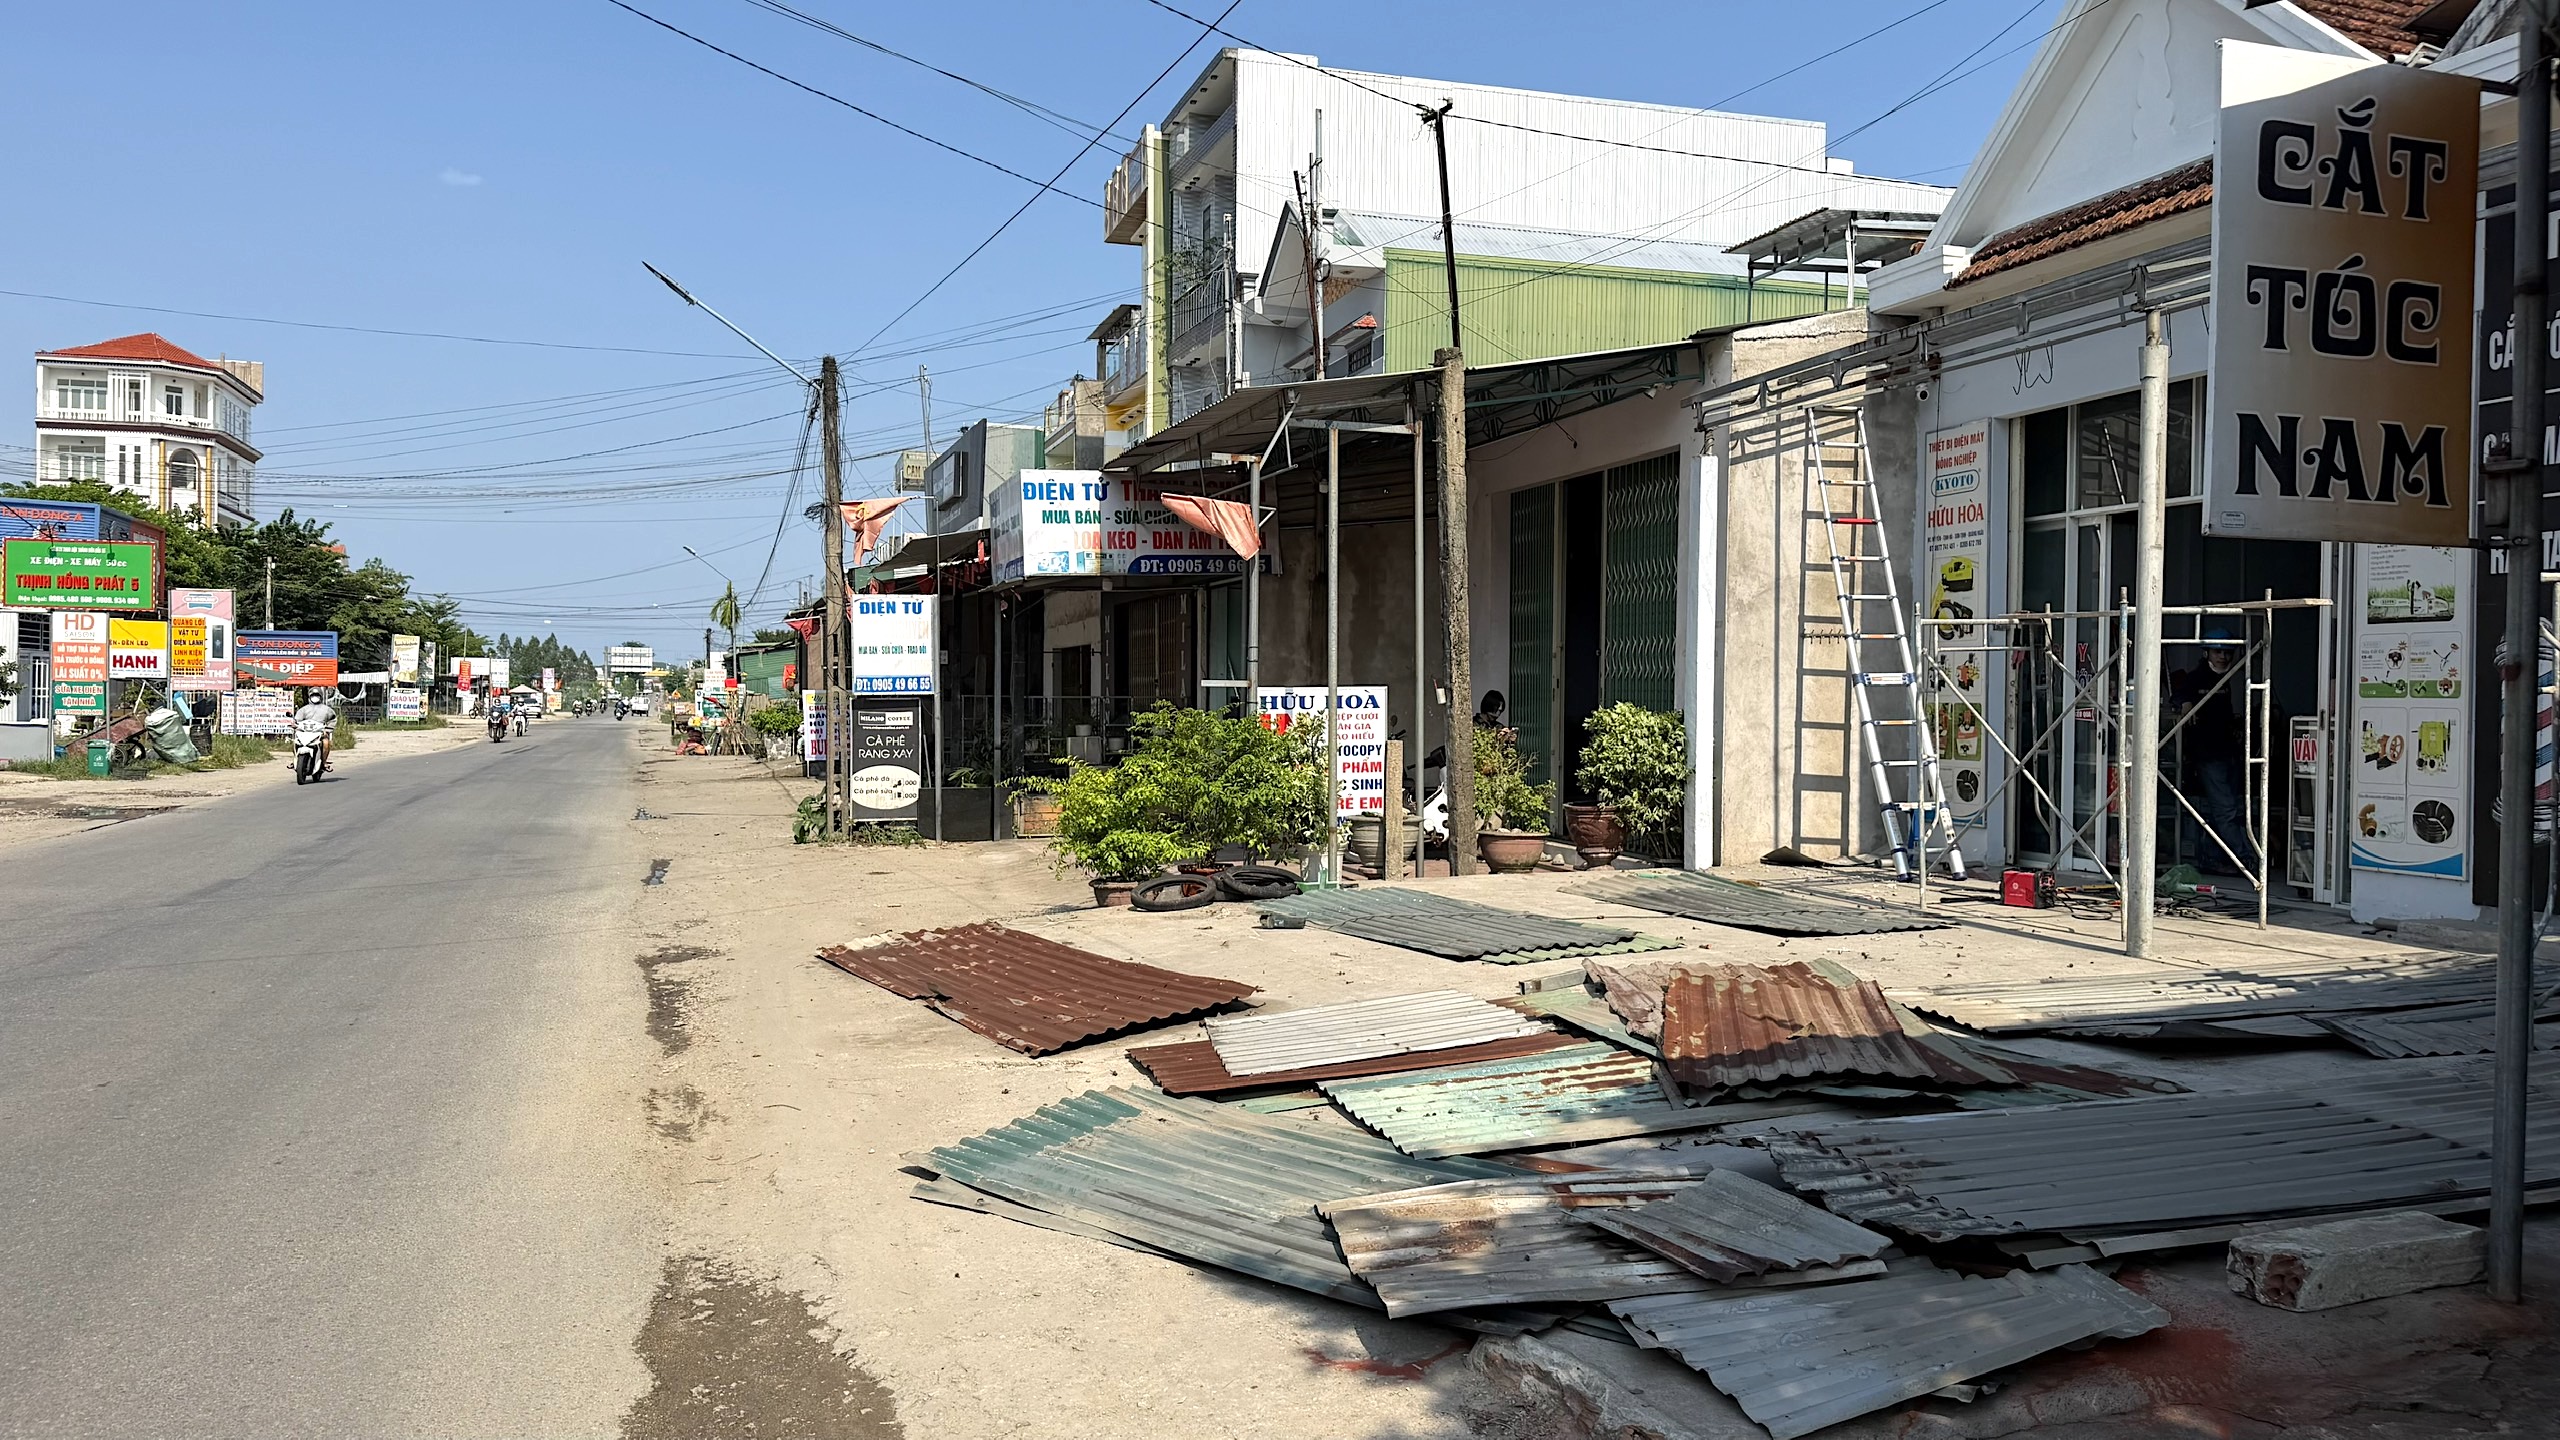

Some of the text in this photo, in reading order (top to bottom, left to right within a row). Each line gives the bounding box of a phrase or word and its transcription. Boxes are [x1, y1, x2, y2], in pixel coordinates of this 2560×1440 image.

[2256, 96, 2449, 223] CẮT
[2245, 252, 2443, 367] TÓC
[2488, 313, 2513, 371] CẮ
[1954, 434, 1969, 449] ĐIỆN
[1970, 431, 1985, 444] MÁY
[1954, 450, 1977, 466] NGHIỆP
[2234, 411, 2452, 509] NAM
[1022, 479, 1075, 504] ĐIỆN
[1082, 477, 1110, 501] TỬ
[1936, 474, 1974, 491] KYOTO
[1042, 510, 1071, 524] MUA
[1075, 508, 1102, 524] BÁN
[1114, 507, 1140, 524] SỬA
[1957, 498, 1984, 523] HÒA
[1107, 528, 1137, 550] KÉO
[1153, 528, 1184, 550] DÀN
[1188, 528, 1217, 550] ÂM
[30, 556, 42, 565] XE
[70, 557, 82, 566] XE
[84, 557, 102, 567] MÁY
[1140, 560, 1164, 573] ĐT:
[1168, 560, 1202, 573] 0905
[1206, 560, 1225, 573] 49
[16, 575, 51, 591] THỊNH
[95, 575, 125, 591] PHÁT
[131, 578, 140, 592] 5
[859, 599, 924, 617] ĐIỆN TỬ
[64, 613, 95, 631] HD
[55, 665, 103, 679] LÃI SUẤT 0%
[280, 660, 314, 676] ĐIỆP
[856, 677, 931, 690] ĐT: 0905 49 66 55
[1259, 692, 1315, 710] HỮU
[1354, 722, 1372, 730] GIA
[886, 734, 906, 746] PHÊ
[1351, 731, 1375, 740] HIẾU
[858, 749, 914, 759] RANG XAY
[1342, 757, 1382, 773] PHẨM
[1352, 779, 1383, 791] SINH
[1336, 794, 1383, 810] RẺ EM
